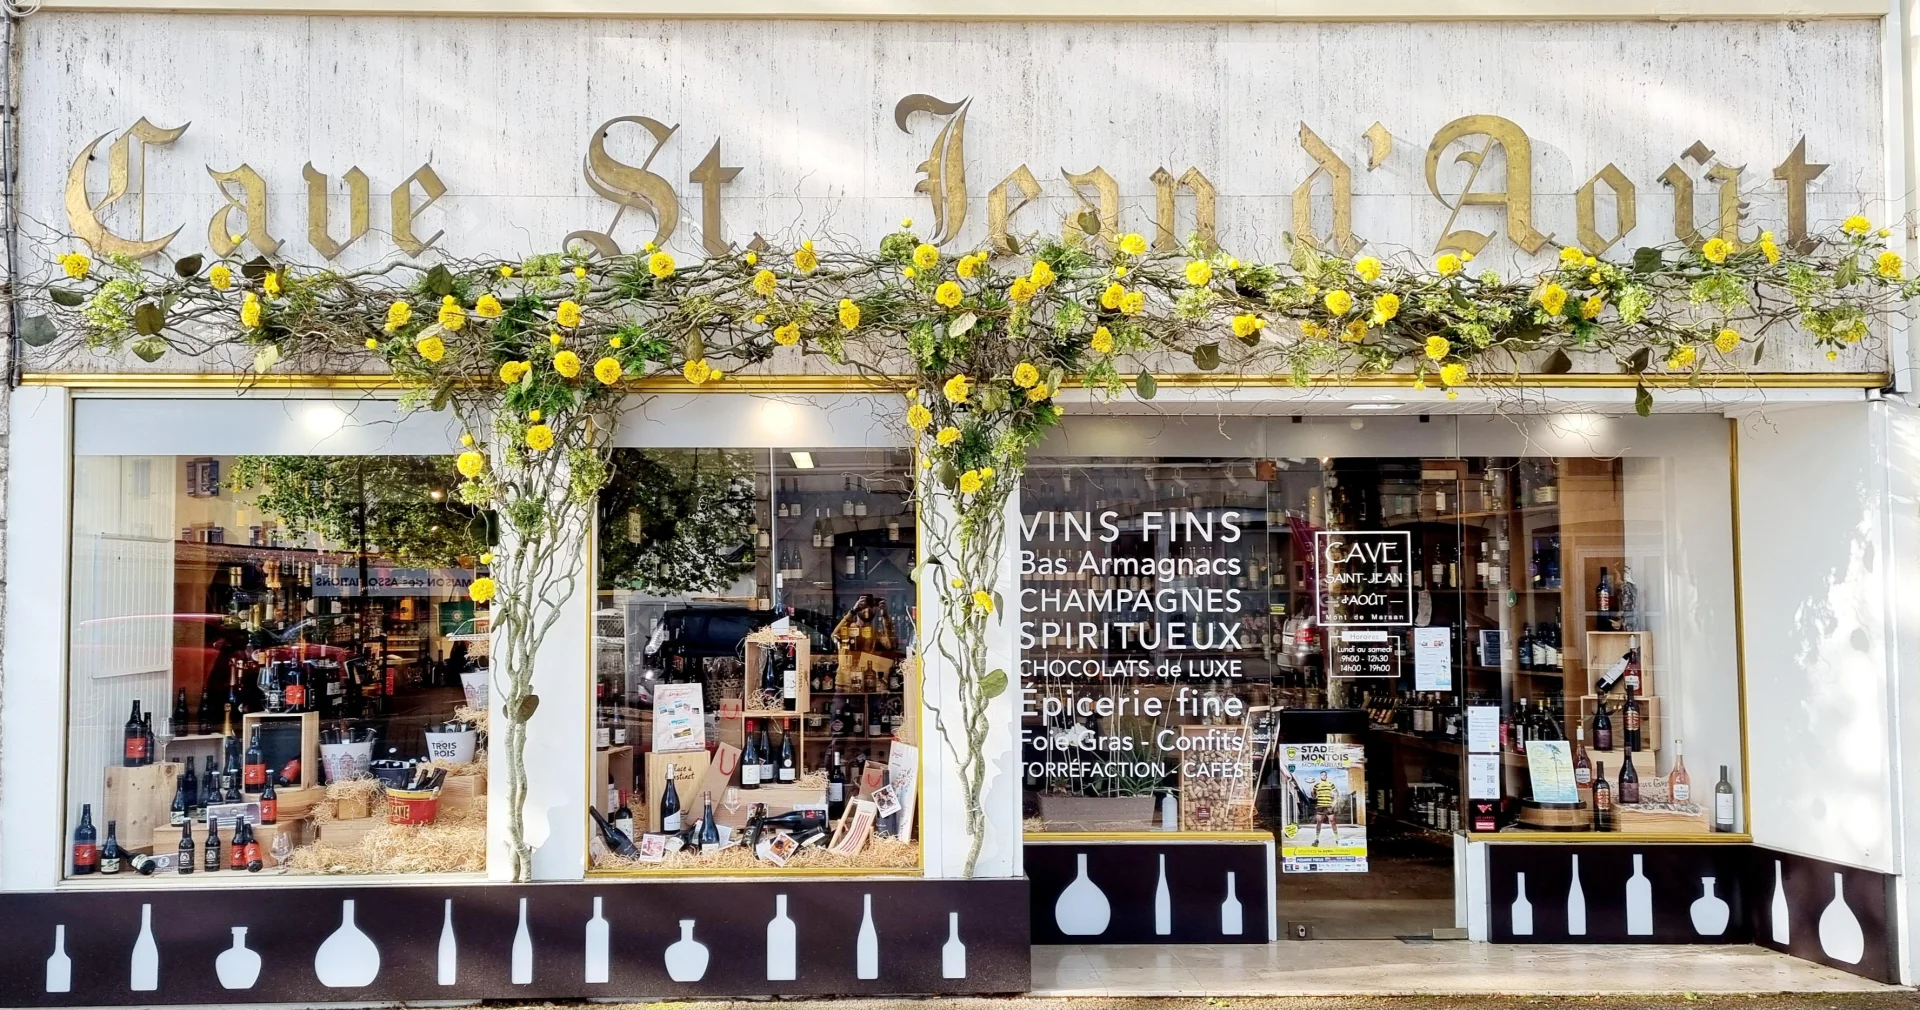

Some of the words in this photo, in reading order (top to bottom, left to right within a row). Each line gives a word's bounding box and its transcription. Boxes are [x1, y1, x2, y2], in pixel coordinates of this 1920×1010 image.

[64, 116, 448, 260] Cave
[562, 116, 772, 257] St.
[895, 94, 1219, 258] Jean
[1020, 511, 1119, 542] VINS
[1143, 511, 1241, 542] FINS
[1325, 542, 1402, 563] CAVE
[1020, 550, 1068, 575] Bas
[1077, 550, 1241, 582] Armagnacs
[1325, 573, 1402, 583] SAINT-JEAN
[1020, 588, 1242, 613] CHAMPAGNES
[1341, 593, 1387, 606] d'AOÛT
[1354, 613, 1365, 621] de
[1021, 622, 1241, 650] SPIRITUEUX
[1350, 633, 1379, 641] Horaires
[1337, 645, 1355, 653] Lundi
[1368, 645, 1393, 653] samedi
[1021, 659, 1150, 677] CHOCOLATS
[1156, 659, 1182, 677] de
[1189, 659, 1242, 677] LUXE
[1021, 682, 1162, 726] Épicerie
[1177, 687, 1243, 717] fine
[431, 742, 457, 750] TROIS
[1022, 729, 1069, 751] Foie
[1077, 729, 1134, 751] Gras
[1157, 728, 1243, 751] Confits
[1022, 759, 1165, 778] TORRÉFACTION
[1183, 759, 1244, 778] CAFÉS
